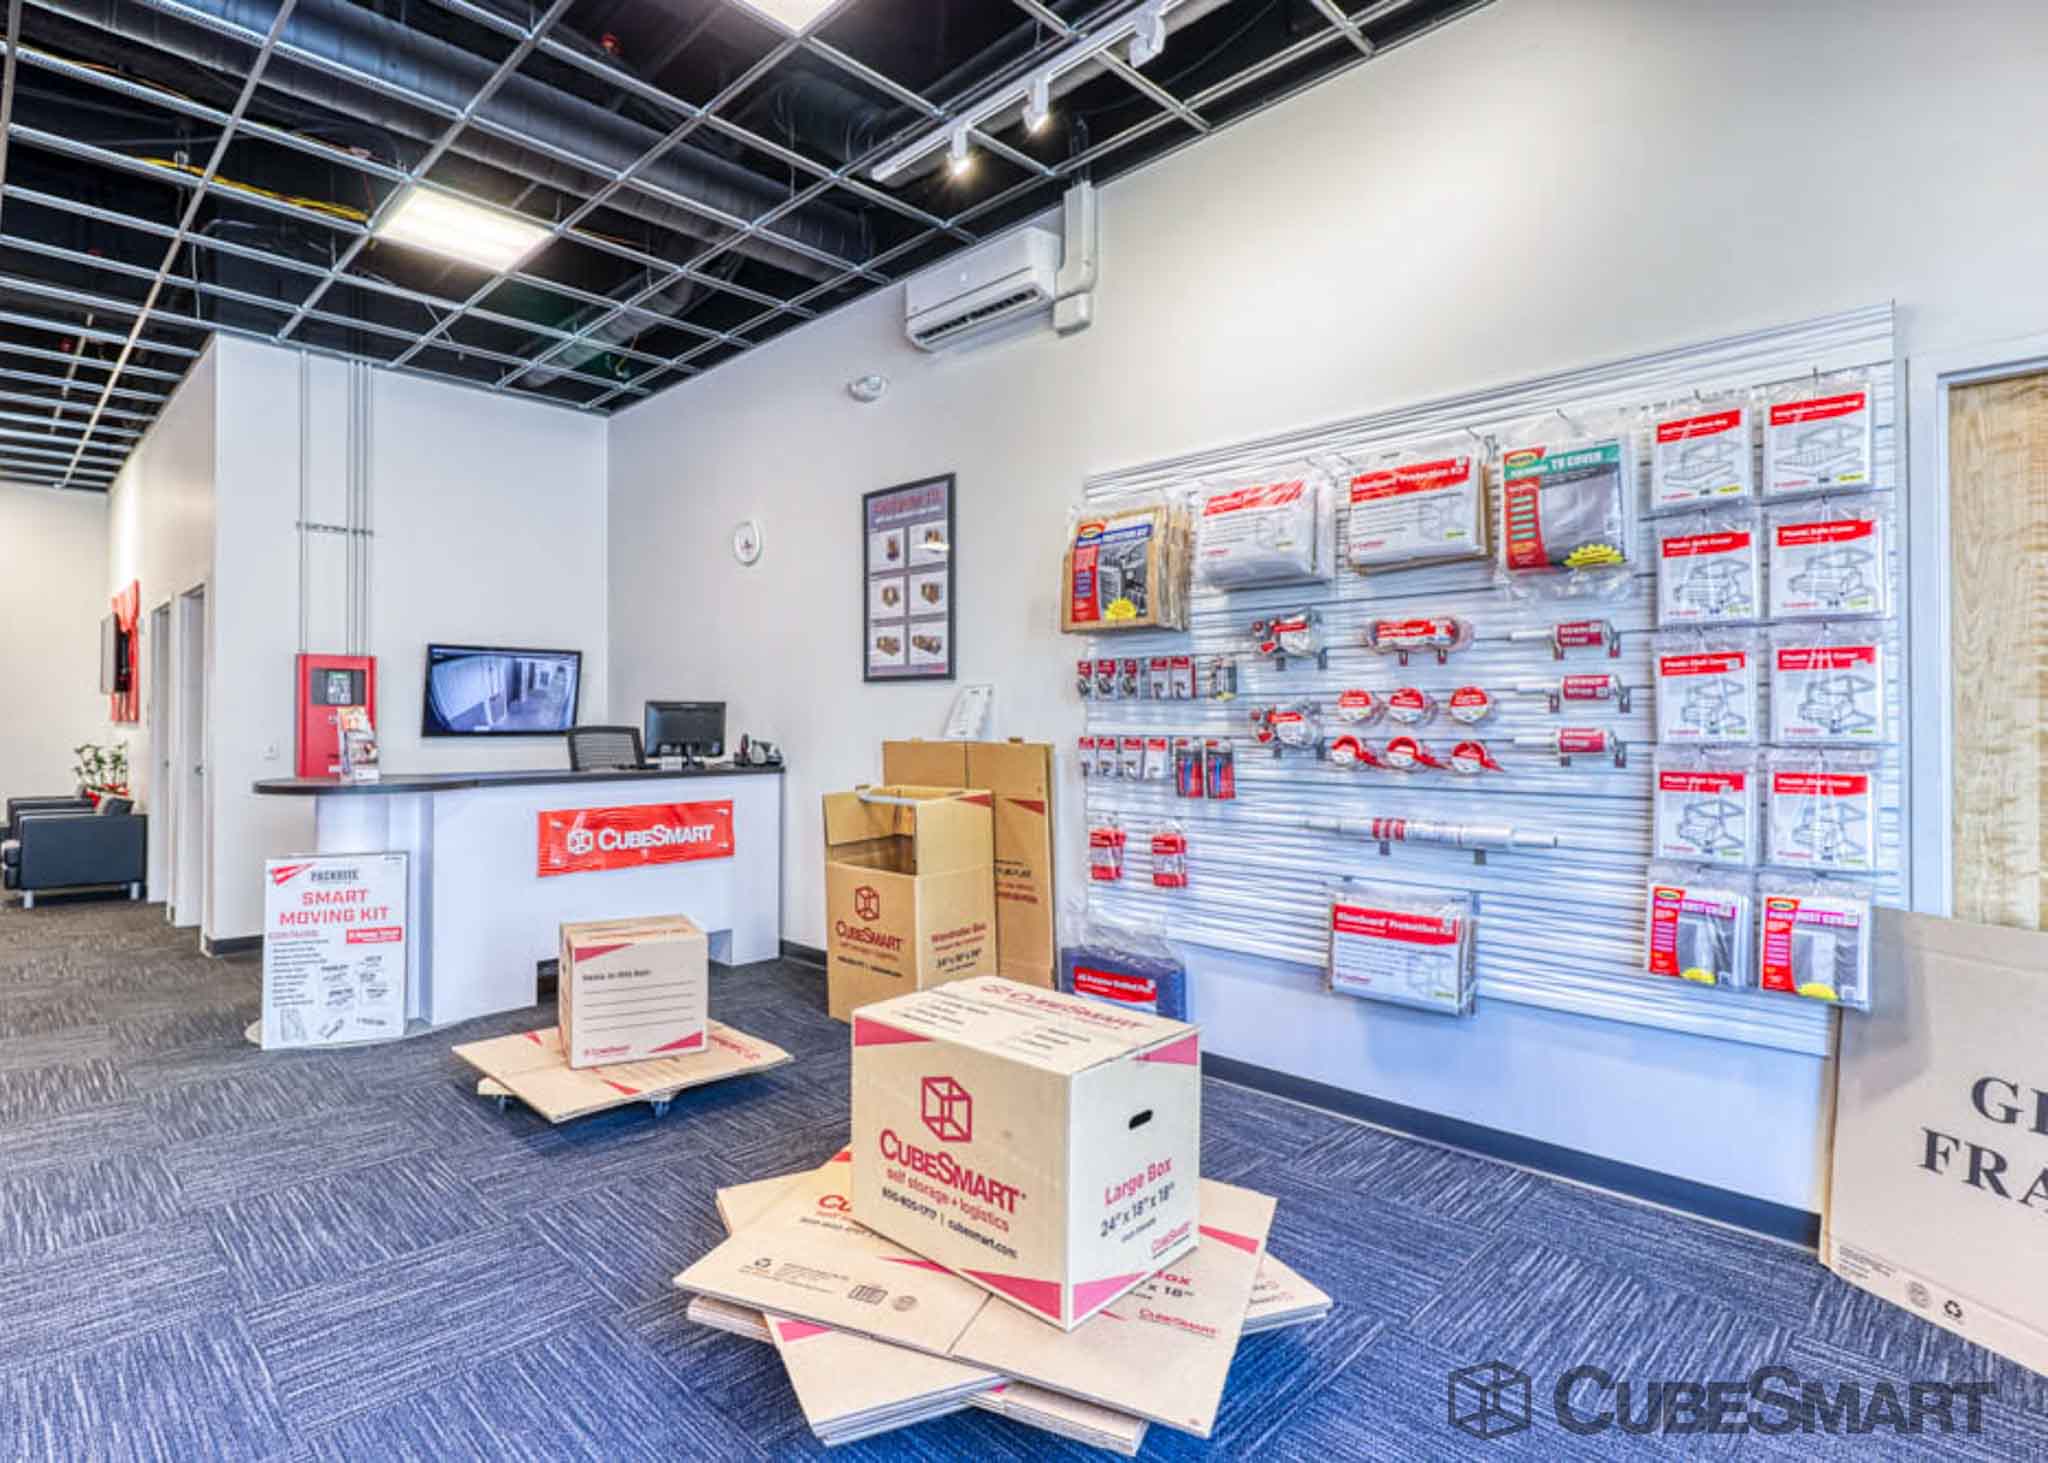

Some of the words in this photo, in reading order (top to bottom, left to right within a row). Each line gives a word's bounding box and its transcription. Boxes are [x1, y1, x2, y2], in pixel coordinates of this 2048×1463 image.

[302, 888, 369, 906] SMART
[279, 908, 356, 926] MOVING
[360, 905, 389, 921] KIT
[1104, 1173, 1145, 1207] Large
[1147, 1157, 1172, 1183] Box
[886, 1167, 906, 1183] self
[908, 1176, 950, 1206] storage
[960, 1197, 1010, 1233] logistics
